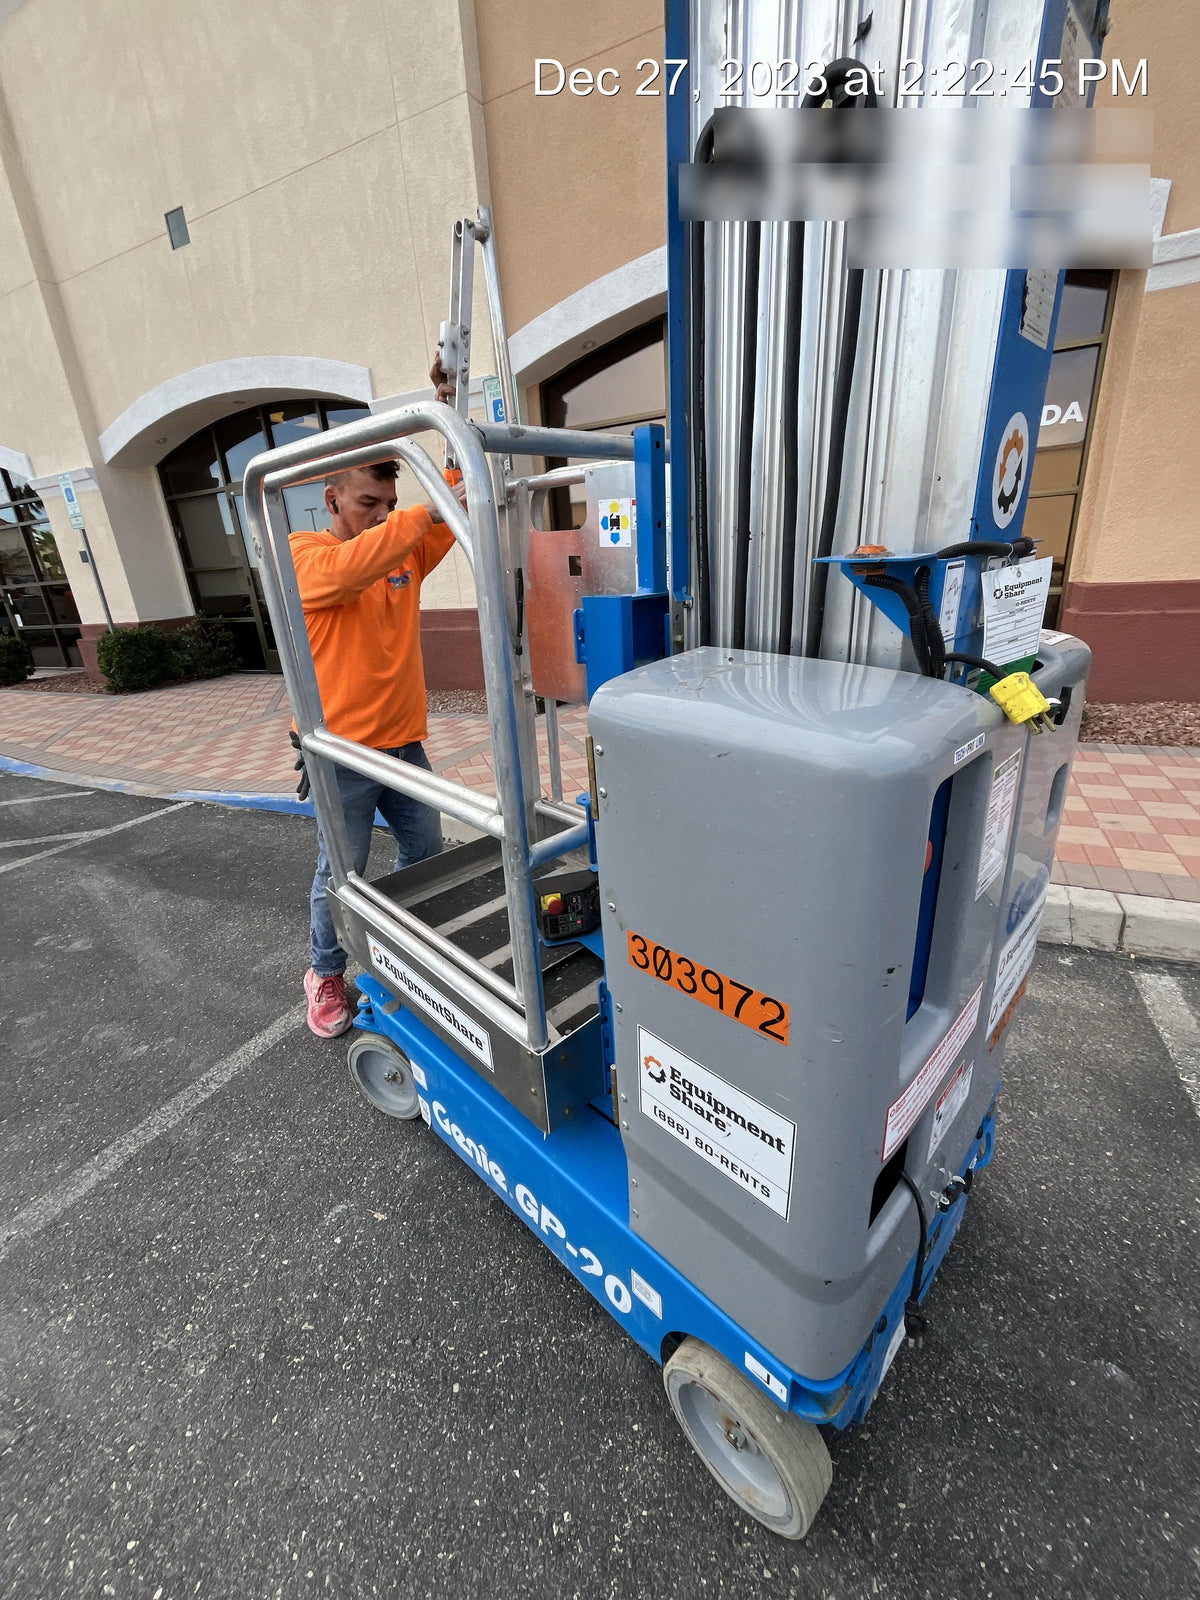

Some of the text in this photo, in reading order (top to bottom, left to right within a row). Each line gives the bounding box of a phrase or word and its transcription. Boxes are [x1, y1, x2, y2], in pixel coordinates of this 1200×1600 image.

[1004, 577, 1043, 592] Equipment
[1004, 588, 1025, 599] Share
[383, 954, 485, 1051] EquipmentShare
[653, 1105, 771, 1199] (888) 80-RENTS
[669, 1082, 727, 1134] Share
[670, 1064, 786, 1155] Equipment
[431, 1100, 633, 1314] Genie GP-20
